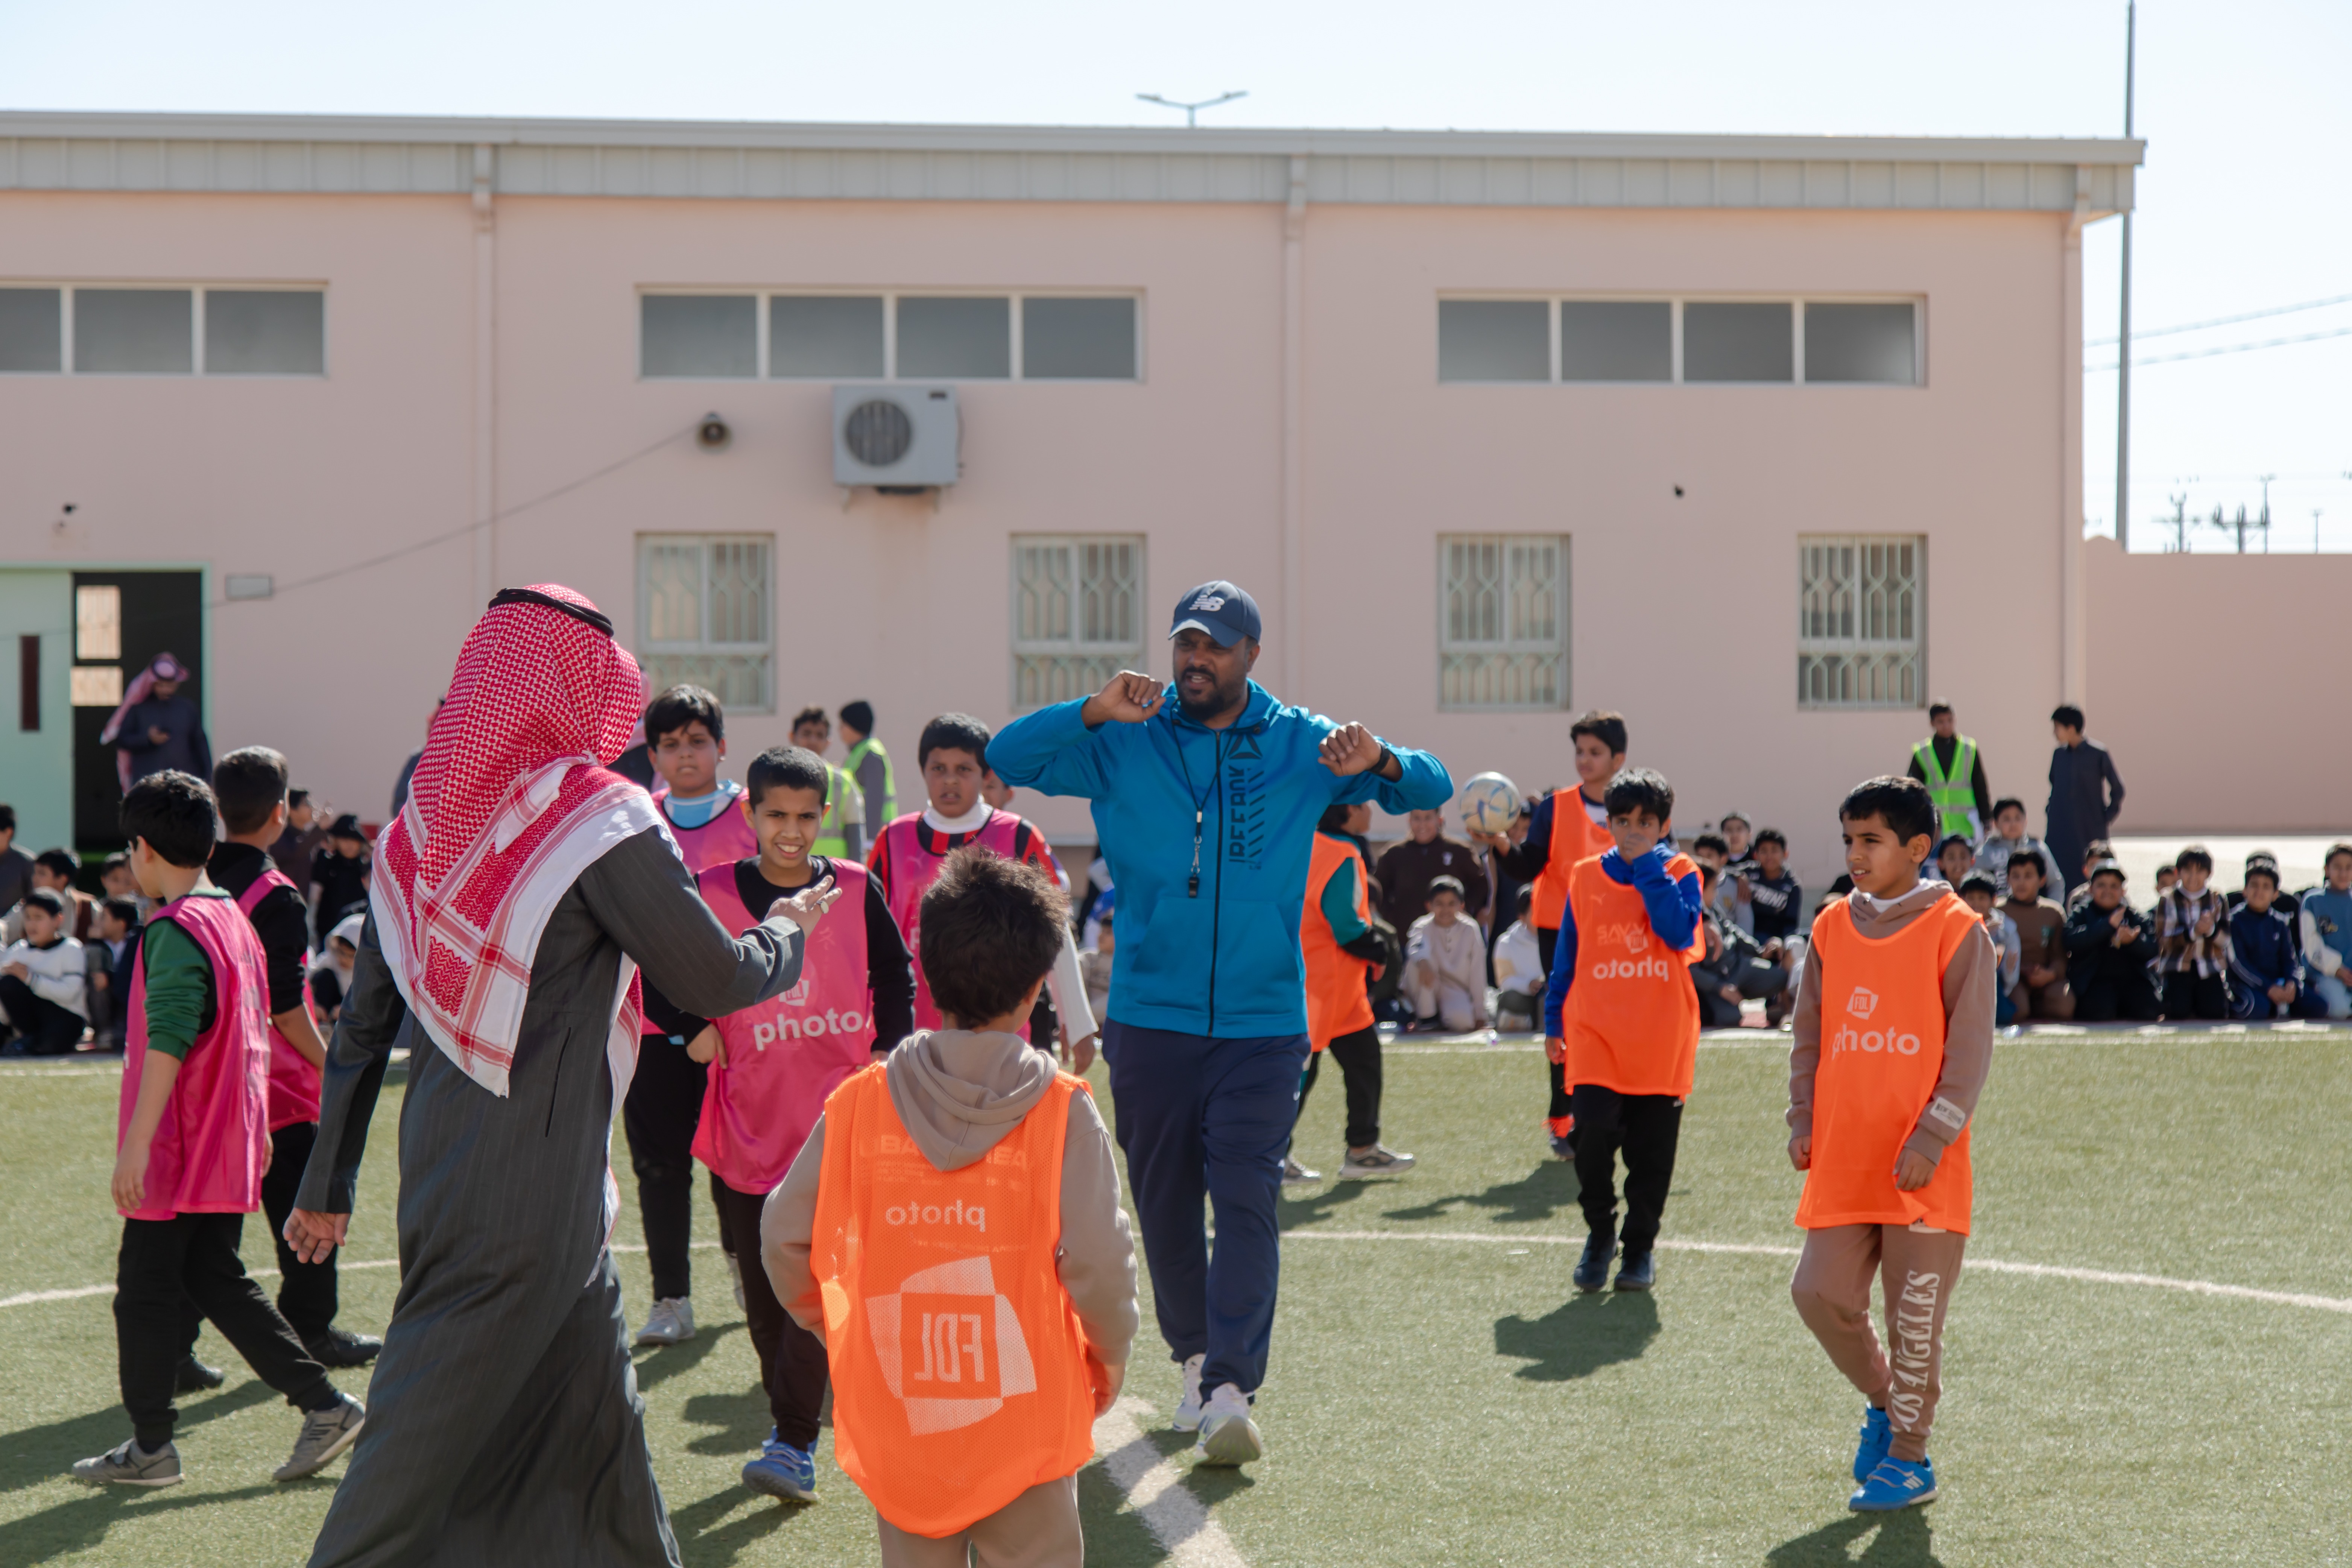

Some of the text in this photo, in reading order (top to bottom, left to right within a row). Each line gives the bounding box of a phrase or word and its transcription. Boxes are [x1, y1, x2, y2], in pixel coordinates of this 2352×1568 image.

[1854, 996, 1869, 1010] FDL
[754, 1007, 863, 1051] photo
[1832, 1023, 1920, 1061] photo
[1895, 1269, 1940, 1391] ANGELES
